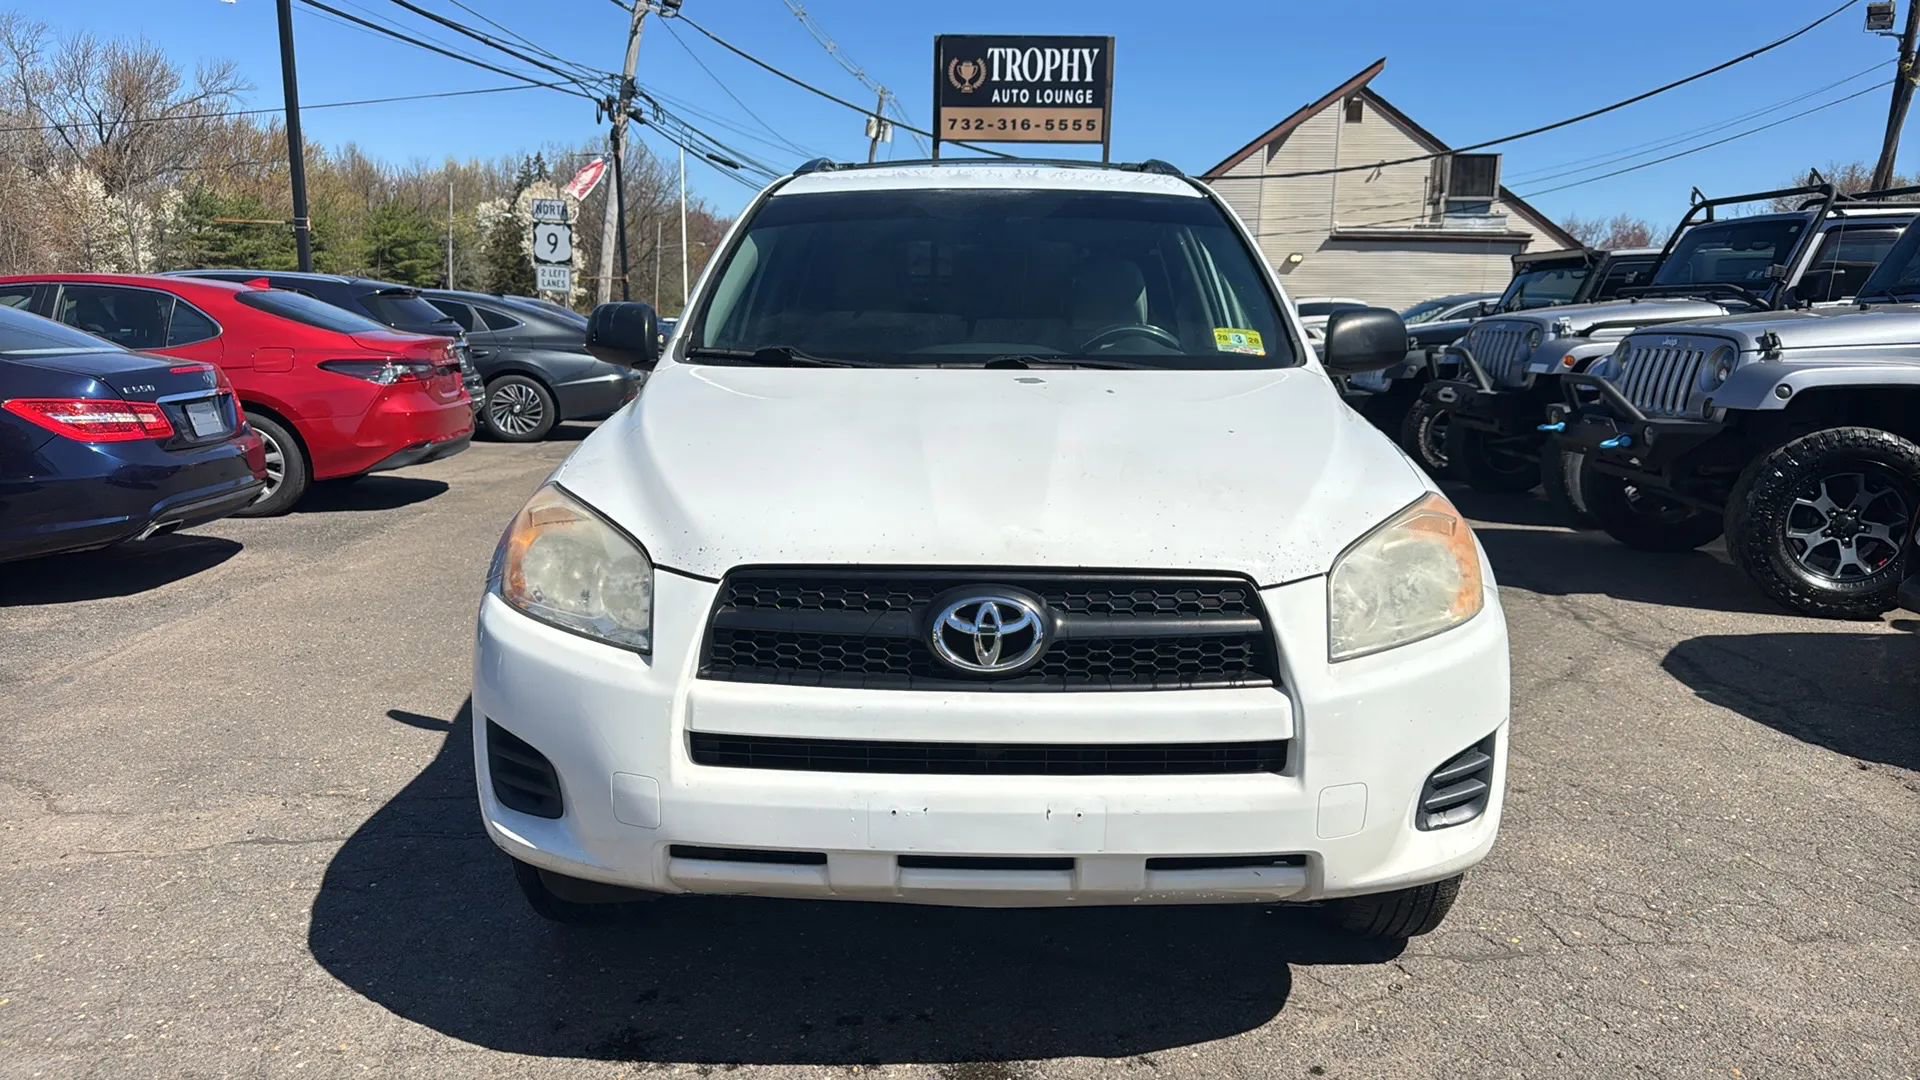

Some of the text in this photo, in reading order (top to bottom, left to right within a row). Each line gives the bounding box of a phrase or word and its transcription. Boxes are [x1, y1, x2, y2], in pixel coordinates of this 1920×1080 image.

[987, 47, 1100, 83] TROPHY
[992, 88, 1093, 104] AUTO LOUNGE
[948, 118, 1097, 131] 732-316-5555
[535, 203, 567, 216] NORTH
[547, 232, 559, 255] 9
[541, 268, 567, 279] 2 LEFT
[542, 280, 566, 289] LANES
